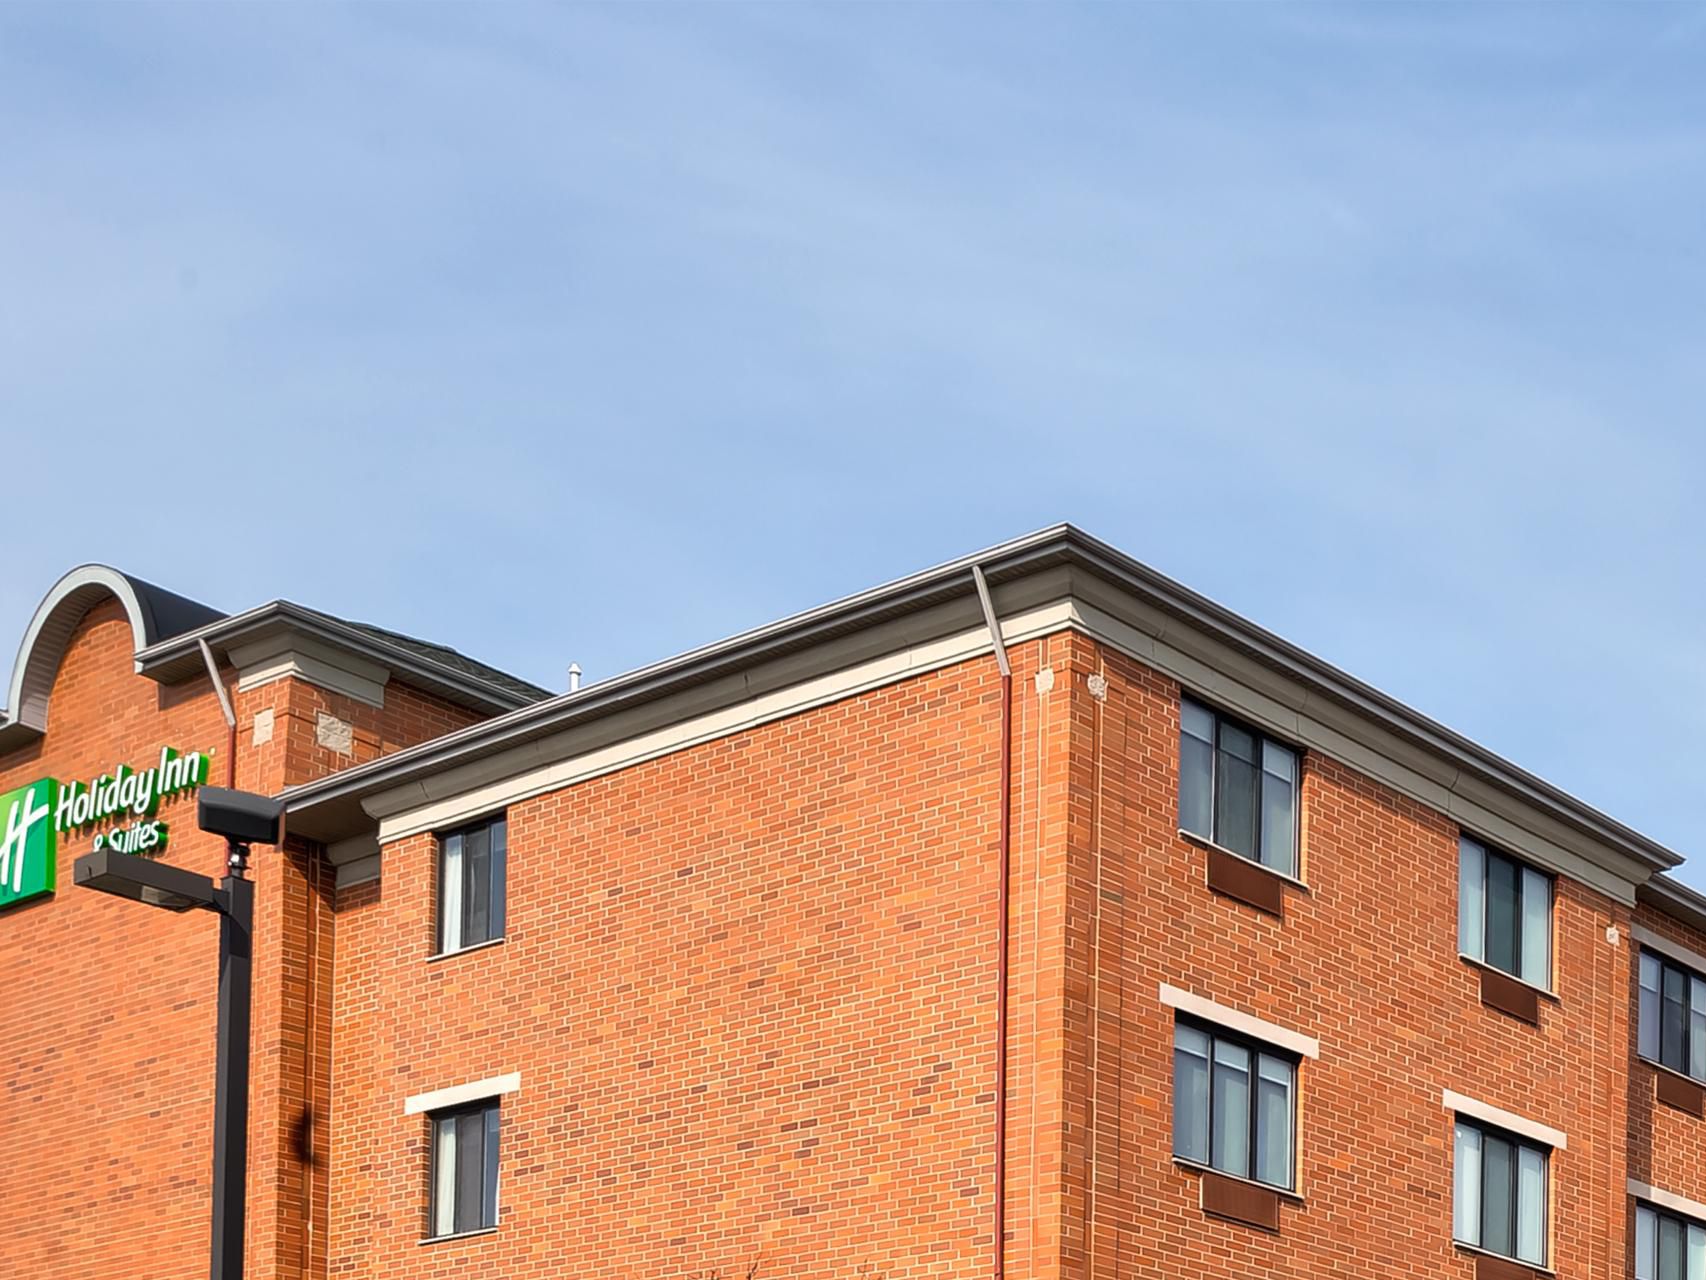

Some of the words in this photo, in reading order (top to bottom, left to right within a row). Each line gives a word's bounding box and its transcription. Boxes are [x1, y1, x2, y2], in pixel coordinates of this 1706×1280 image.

[54, 764, 155, 831] Holiday
[156, 746, 200, 795] Inn
[108, 820, 161, 854] Suites
